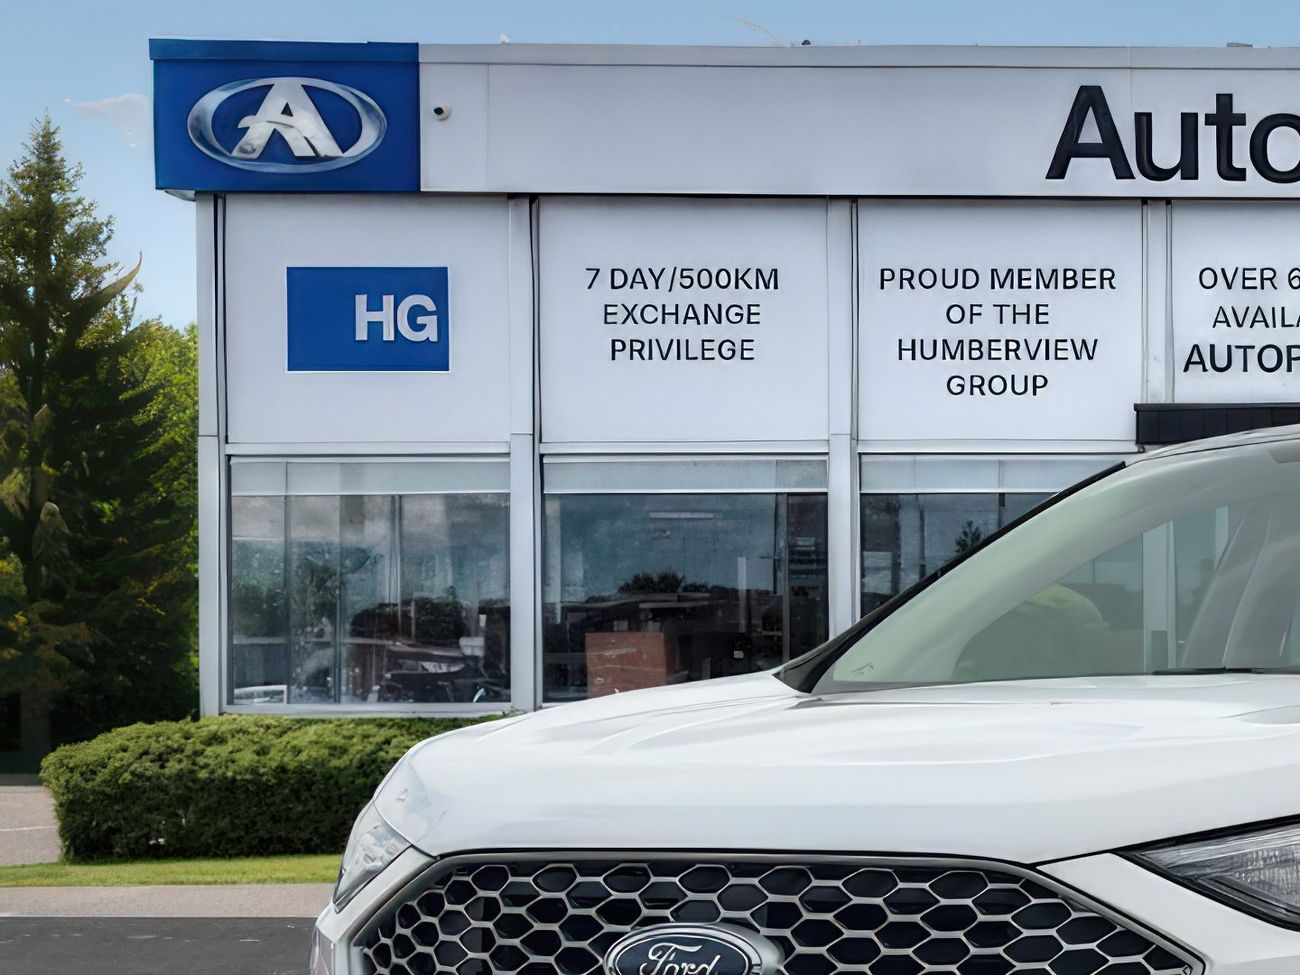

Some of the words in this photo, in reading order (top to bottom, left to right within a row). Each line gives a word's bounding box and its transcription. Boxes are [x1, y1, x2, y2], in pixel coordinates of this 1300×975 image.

[585, 267, 601, 290] 7
[610, 266, 779, 293] DAY/500KM
[879, 267, 980, 291] PROUD
[990, 267, 1116, 290] MEMBER
[1198, 266, 1278, 291] OVER
[355, 294, 438, 342] HG
[603, 303, 761, 326] EXCHANGE
[945, 303, 983, 325] OF
[992, 303, 1049, 325] THE
[611, 338, 755, 361] PRIVILEGE
[898, 338, 1099, 361] HUMBERVIEW
[946, 374, 1049, 397] GROUP
